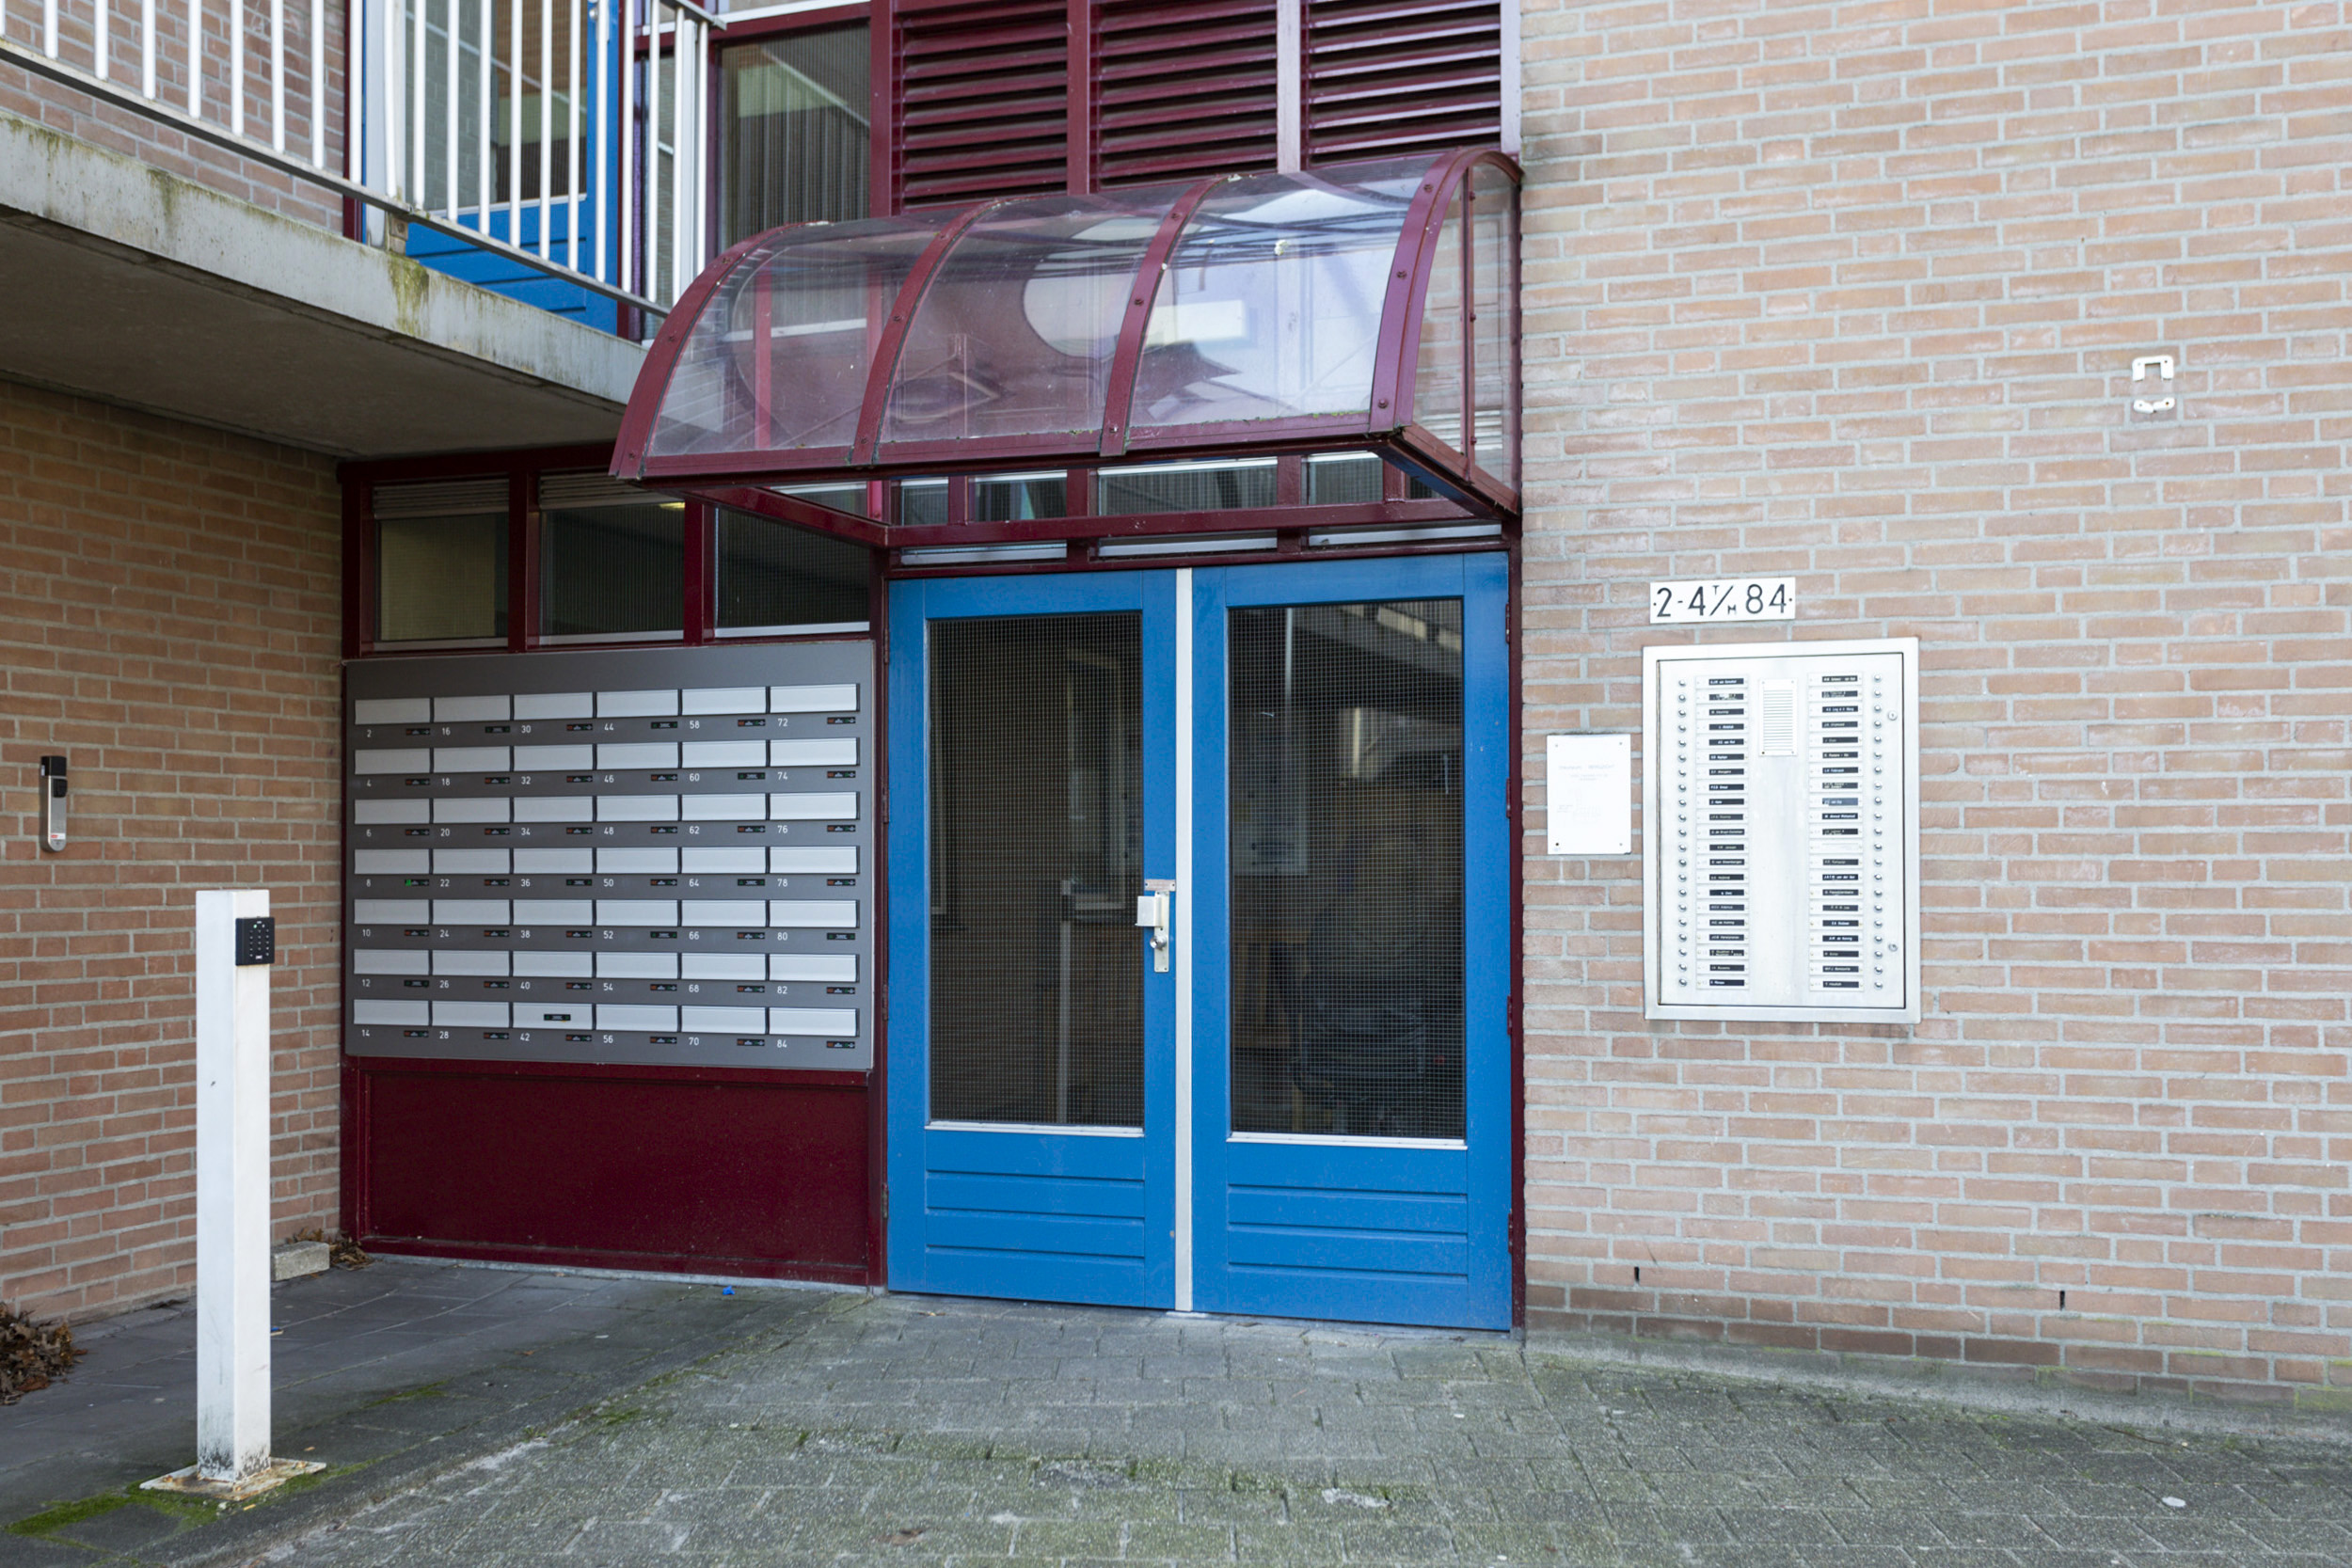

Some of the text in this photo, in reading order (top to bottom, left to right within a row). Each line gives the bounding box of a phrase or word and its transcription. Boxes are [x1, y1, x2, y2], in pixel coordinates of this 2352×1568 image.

[1745, 583, 1787, 614] 84
[604, 721, 614, 732] 44
[689, 720, 700, 730] 58
[777, 718, 788, 727] 72
[441, 726, 452, 736] 16
[521, 724, 532, 734] 30
[521, 775, 532, 785] 32
[604, 774, 614, 784] 46
[689, 772, 701, 783] 60
[777, 771, 788, 781] 74
[441, 777, 451, 786] 18
[440, 828, 451, 837] 20
[520, 827, 531, 836] 34
[603, 826, 614, 835] 48
[689, 825, 700, 835] 62
[777, 824, 788, 834] 76
[439, 879, 451, 888] 22
[520, 878, 532, 888] 36
[603, 878, 614, 887] 50
[689, 878, 700, 888] 64
[777, 878, 788, 888] 78
[362, 928, 372, 938] 10
[439, 928, 451, 939] 24
[520, 929, 531, 939] 38
[603, 929, 614, 940] 52
[689, 930, 700, 941] 66
[777, 931, 788, 942] 80
[361, 978, 371, 988] 12
[439, 979, 450, 989] 26
[519, 981, 531, 990] 40
[603, 982, 613, 991] 54
[688, 984, 700, 993] 68
[776, 985, 788, 995] 82
[361, 1028, 372, 1038] 14
[439, 1030, 450, 1039] 28
[519, 1032, 531, 1042] 42
[603, 1034, 614, 1044] 56
[688, 1037, 700, 1046] 70
[776, 1038, 787, 1049] 84
